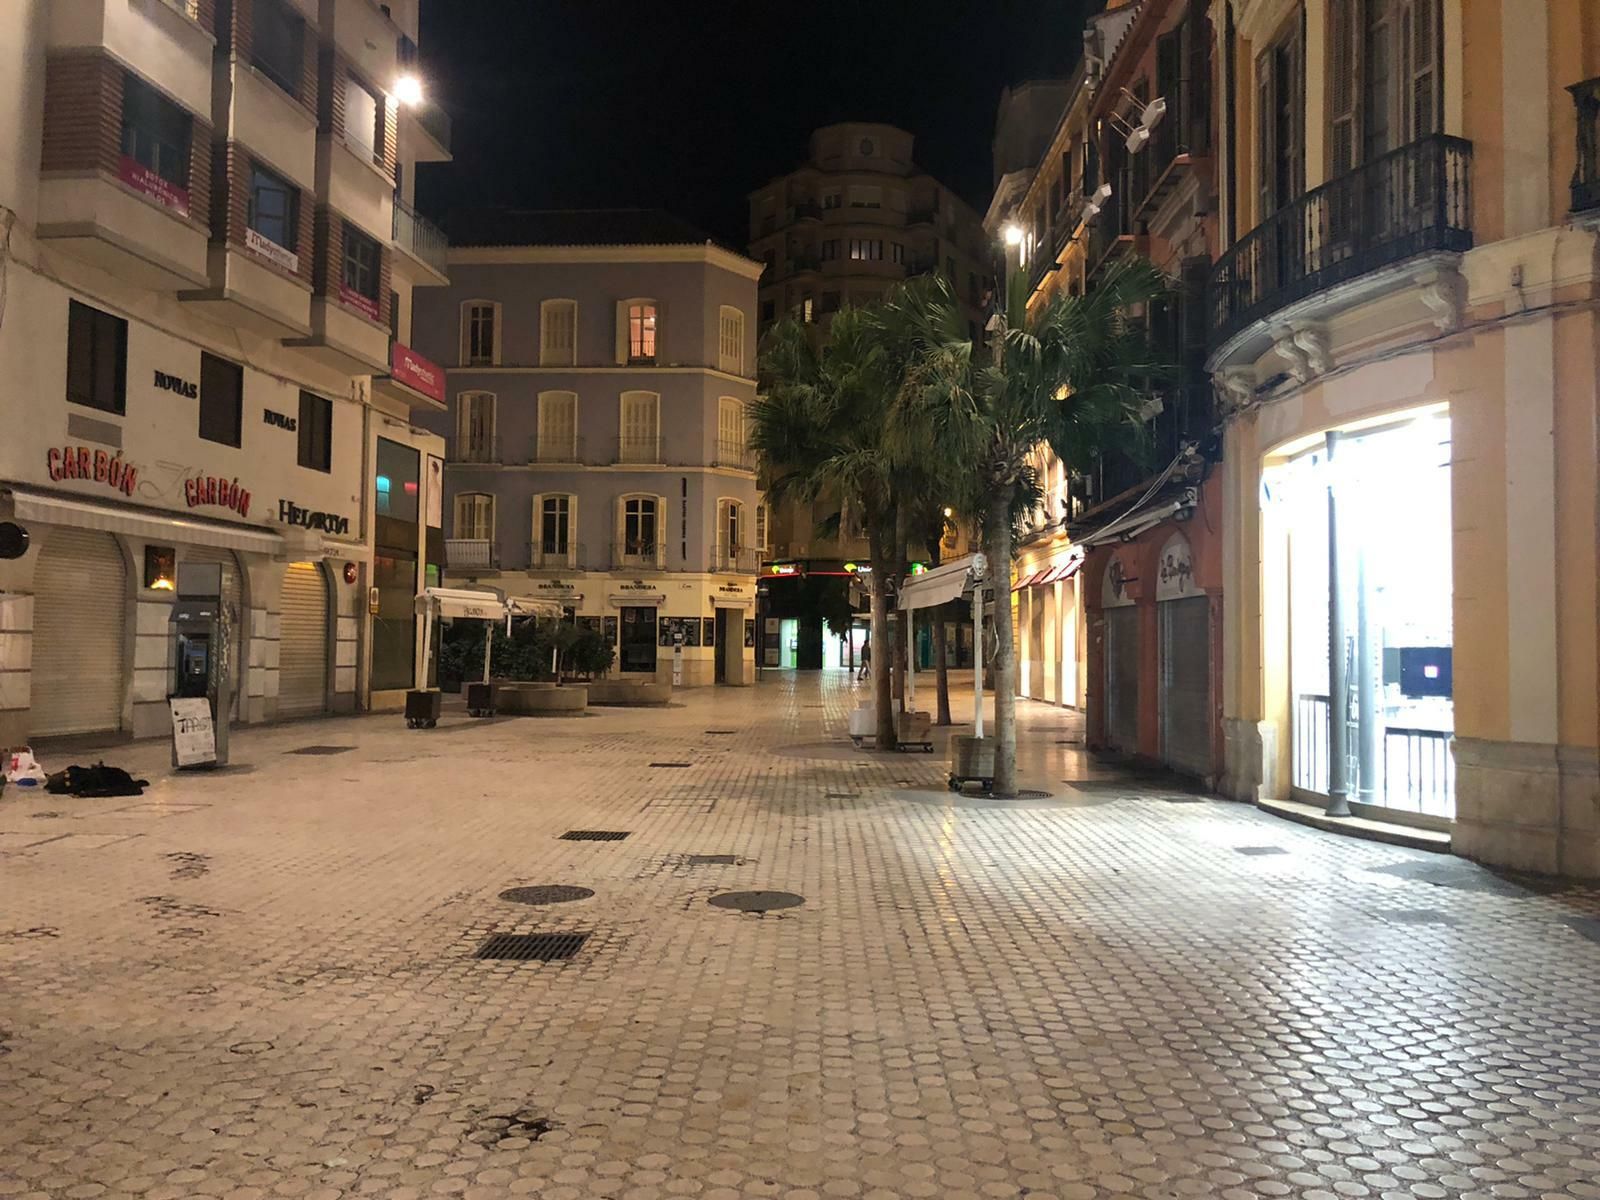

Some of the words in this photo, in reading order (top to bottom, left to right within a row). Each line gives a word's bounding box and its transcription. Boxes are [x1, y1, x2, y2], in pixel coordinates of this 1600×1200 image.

[154, 369, 198, 400] NOVIAS
[263, 408, 297, 432] NOVIAS
[48, 446, 138, 497] CARBÓN
[185, 476, 251, 518] CARBÓN
